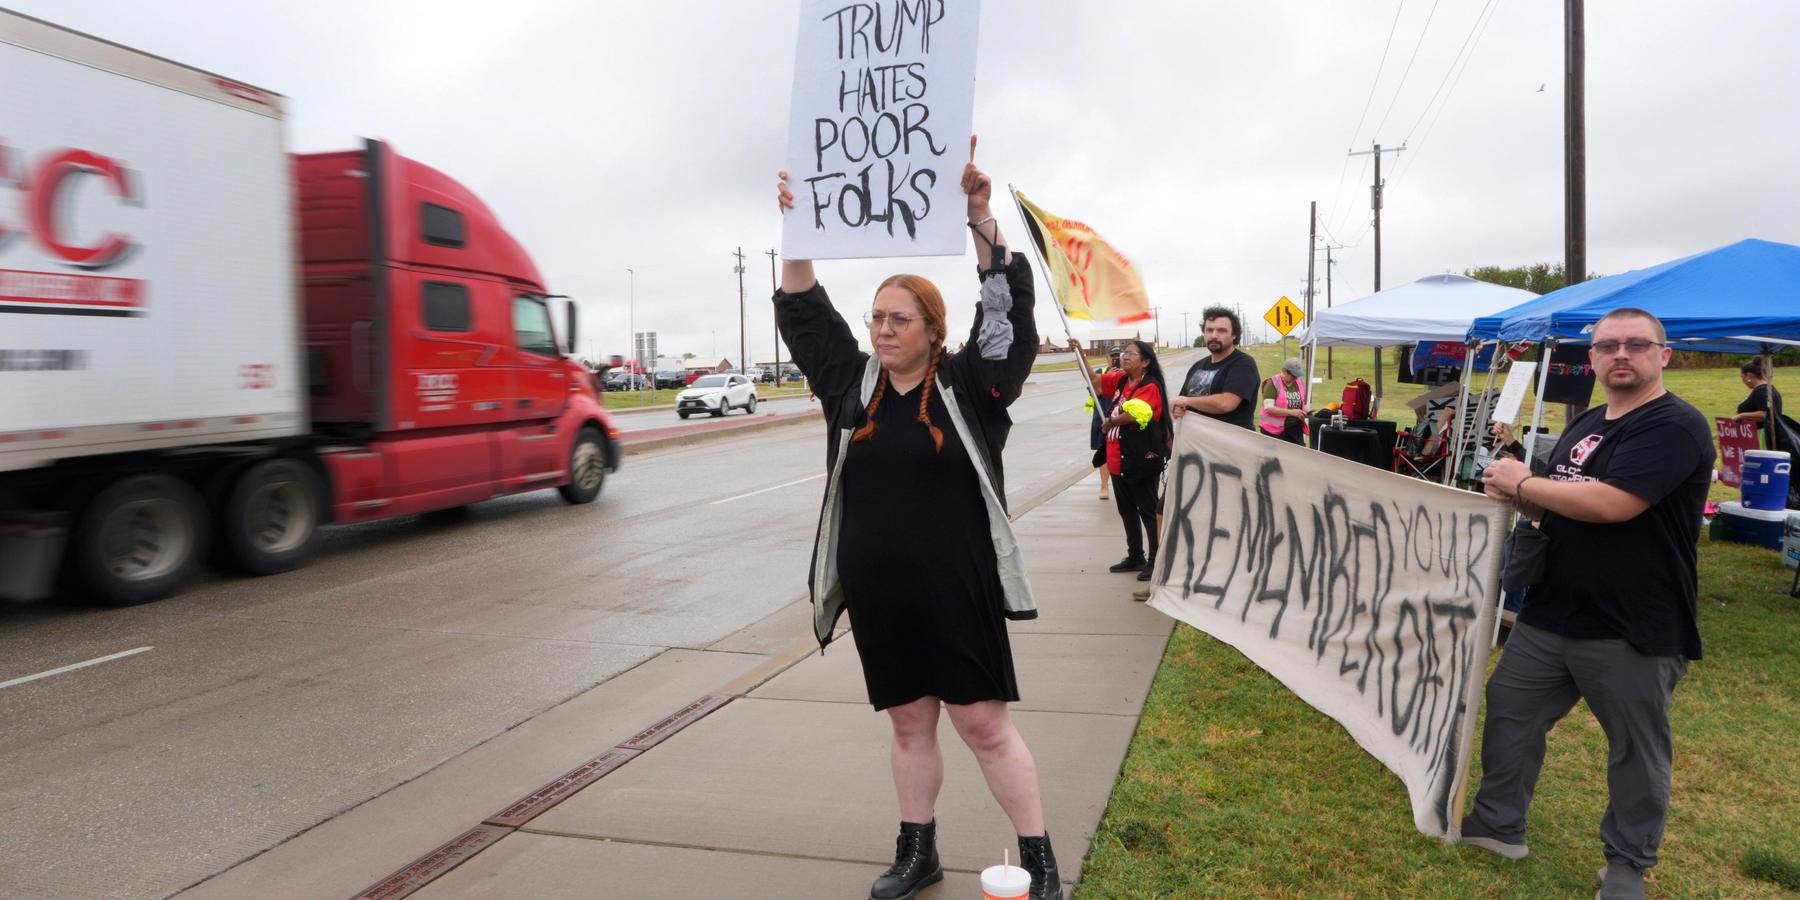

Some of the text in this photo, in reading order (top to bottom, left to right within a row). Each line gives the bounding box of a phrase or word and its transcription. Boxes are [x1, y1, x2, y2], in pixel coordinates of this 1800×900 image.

[822, 0, 945, 60] TRUMP
[839, 62, 927, 116] HATES
[815, 103, 947, 173] POOR
[804, 159, 937, 240] FOLKS
[1740, 424, 1753, 438] US
[1162, 451, 1490, 720] REMEMBER YOUR
